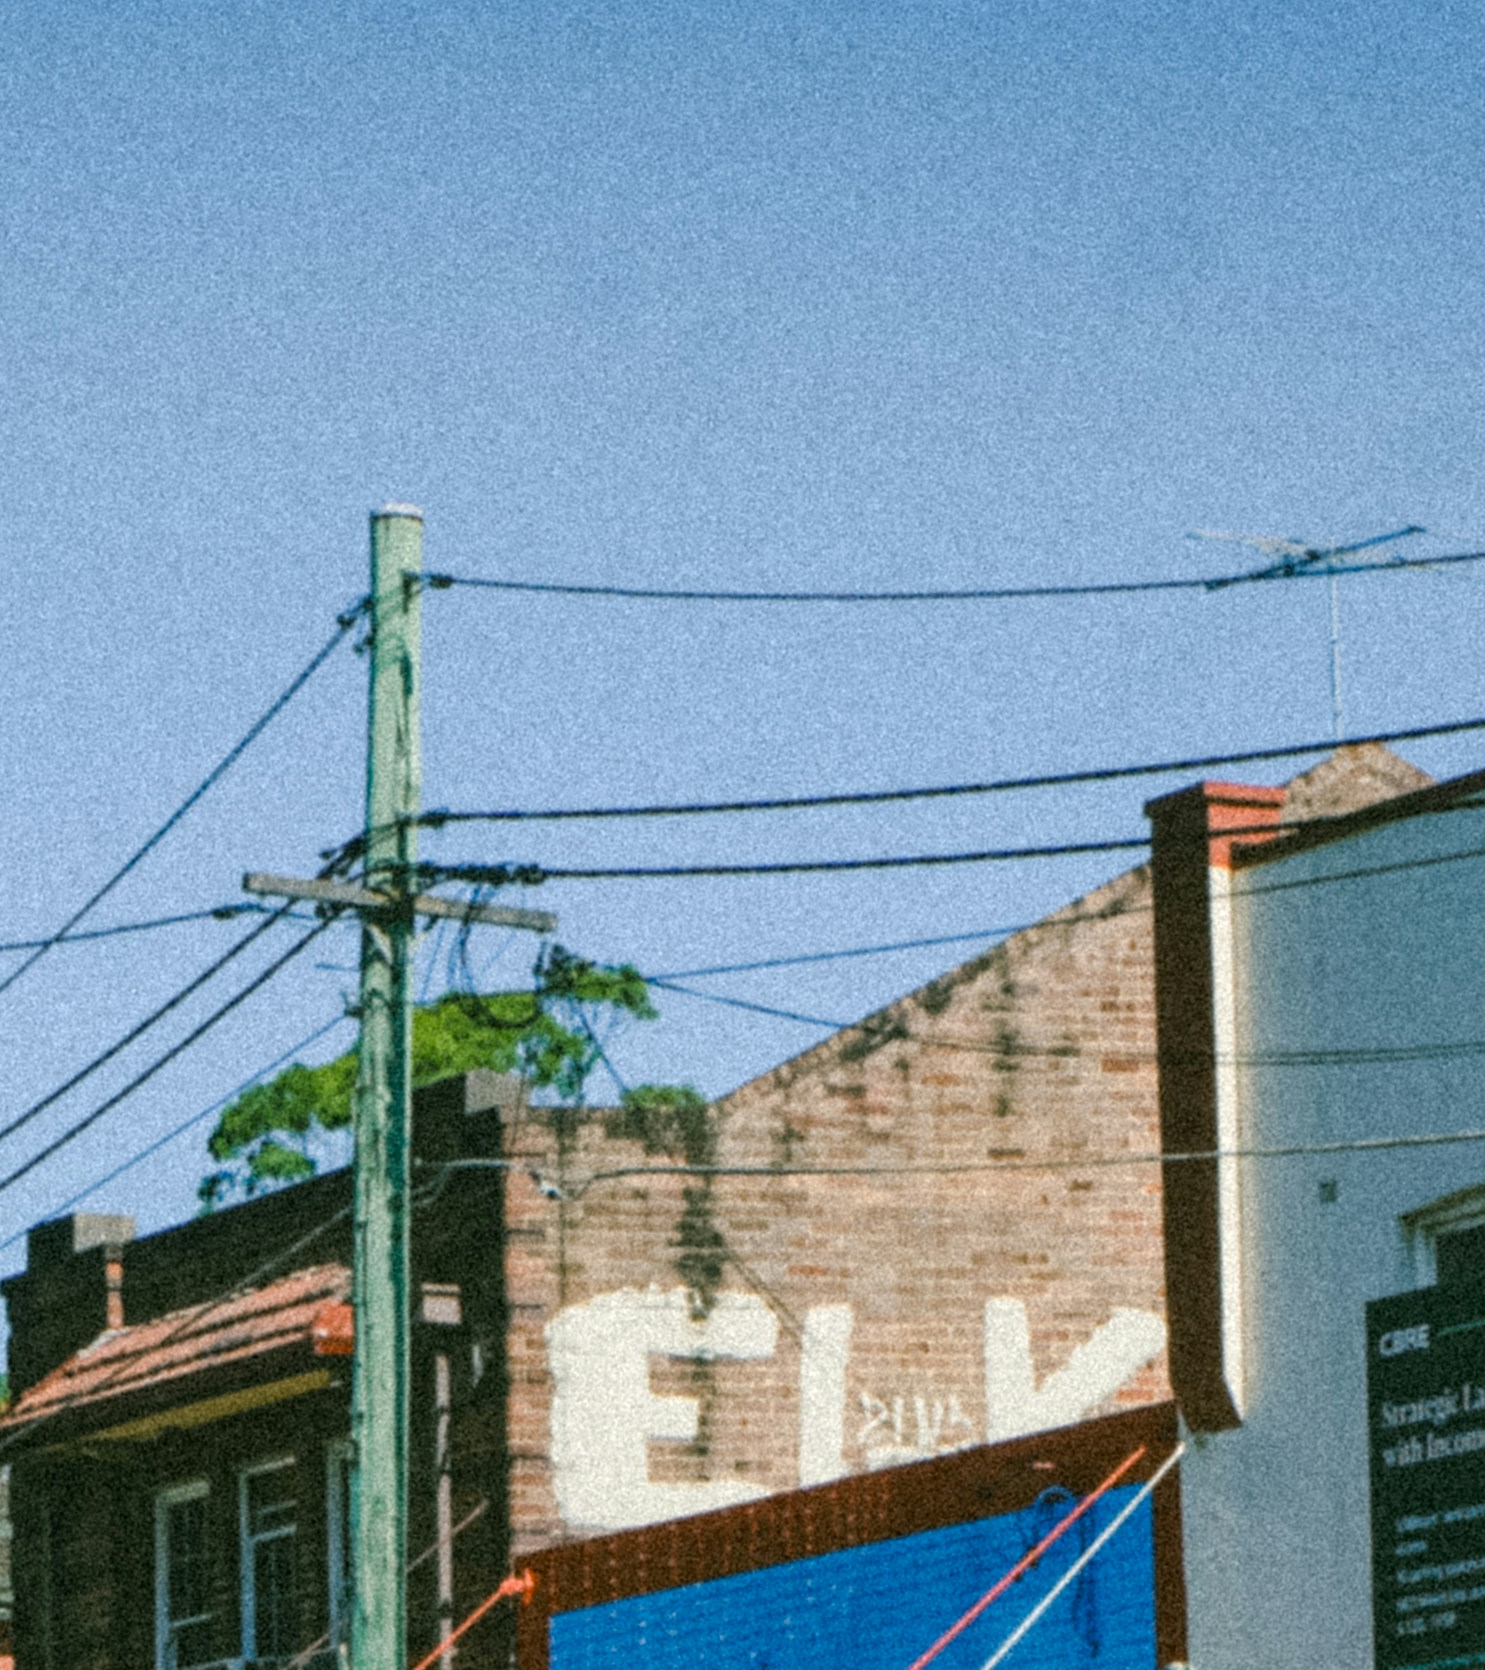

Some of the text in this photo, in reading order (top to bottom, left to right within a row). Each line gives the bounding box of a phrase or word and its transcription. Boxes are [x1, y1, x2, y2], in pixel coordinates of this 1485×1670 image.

[1379, 1323, 1430, 1358] CBRE
[1382, 1386, 1459, 1430] Strategic
[1383, 1435, 1423, 1468] with
